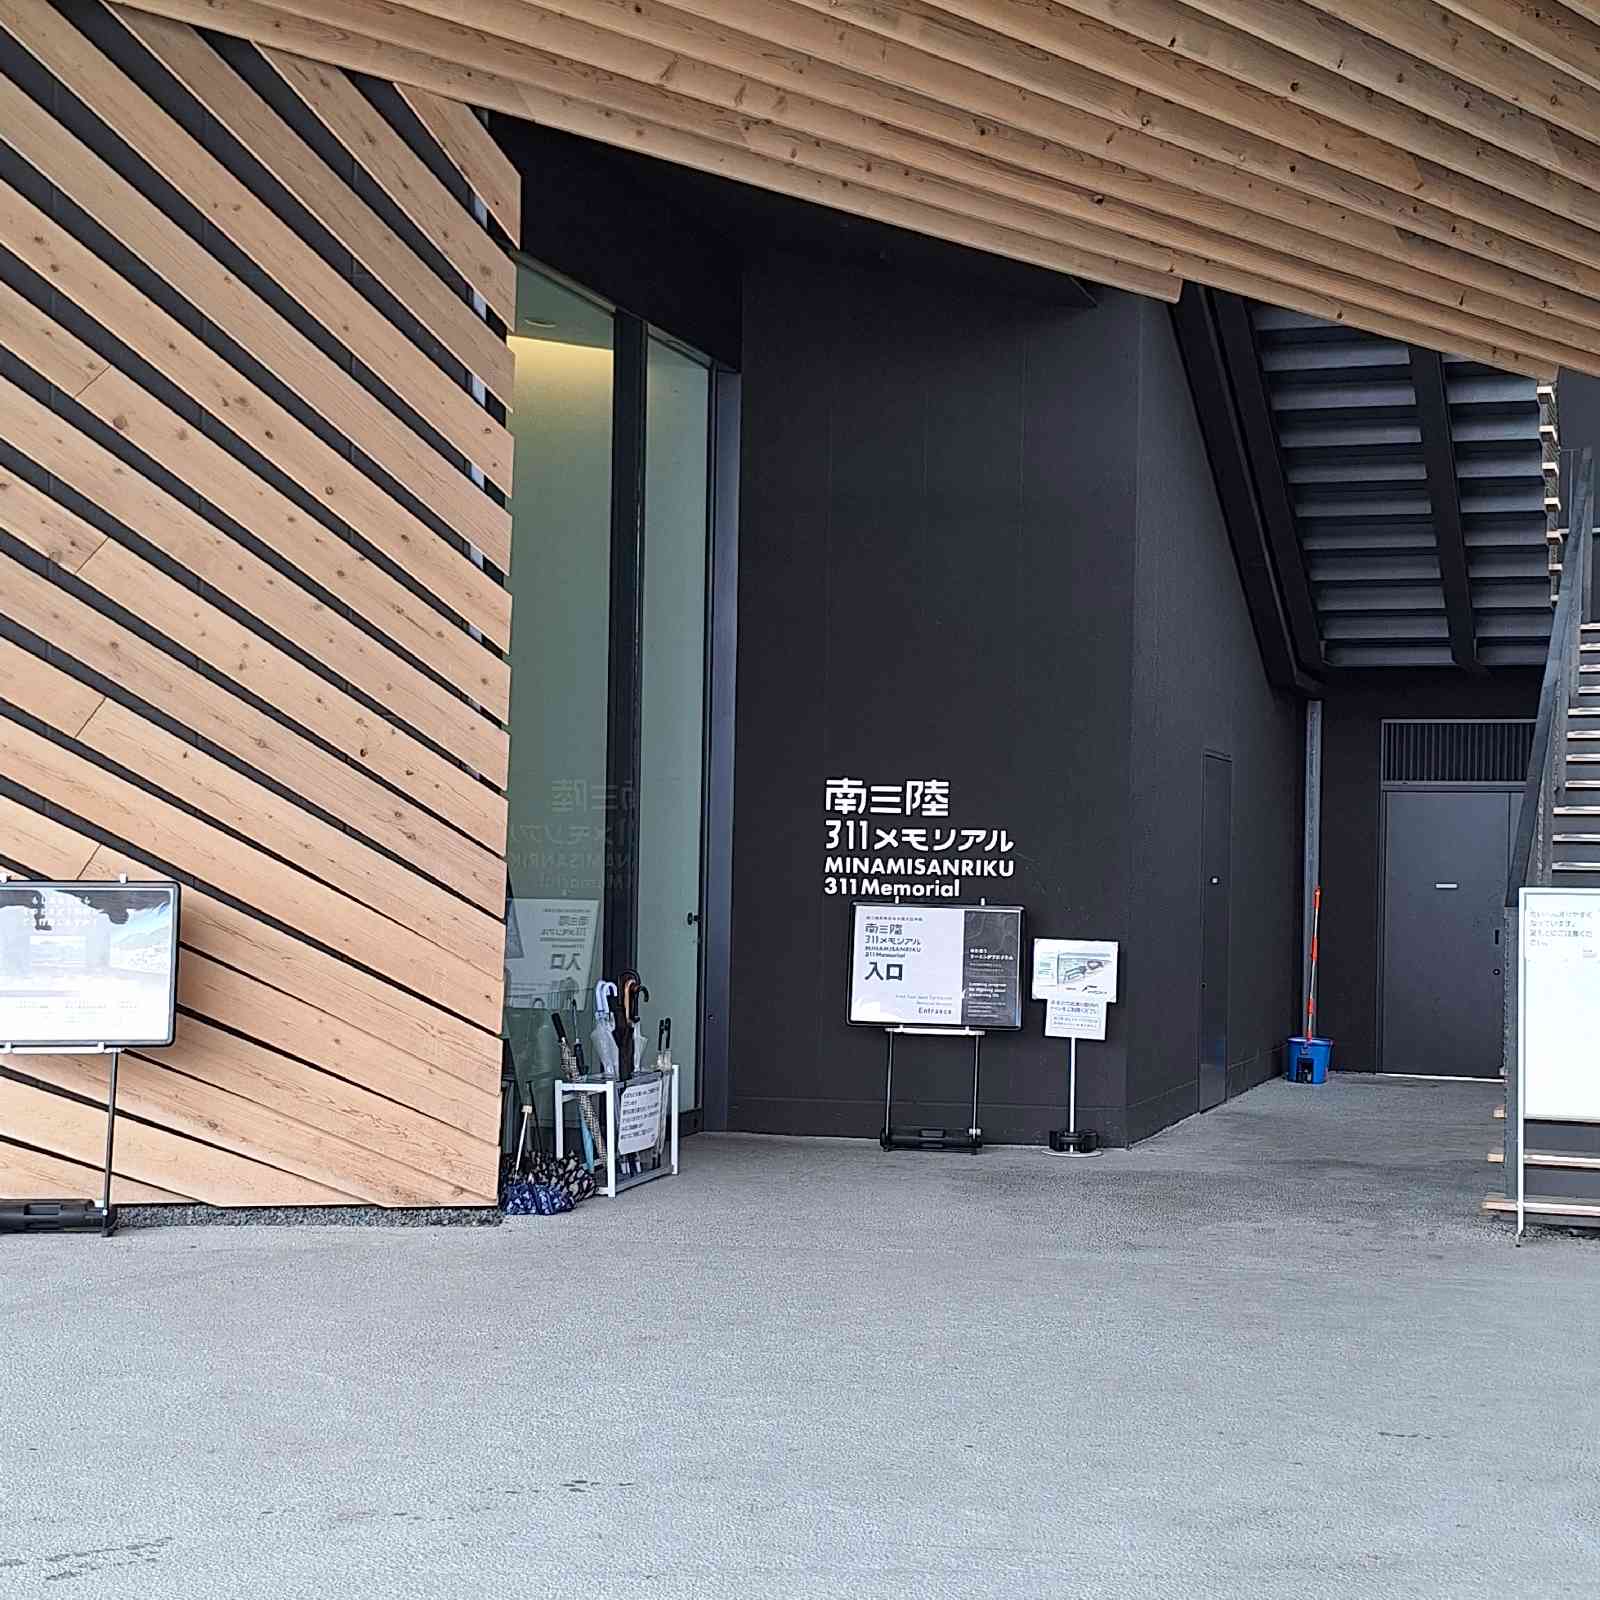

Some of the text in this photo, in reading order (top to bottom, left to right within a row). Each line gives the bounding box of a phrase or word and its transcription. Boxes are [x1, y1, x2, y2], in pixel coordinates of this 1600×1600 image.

[825, 778, 950, 816] 南三陸
[825, 820, 1014, 852] 311メモリアル
[824, 856, 1014, 877] MINAMISANRIKU
[865, 923, 903, 935] 南三陸
[864, 961, 903, 981] 入口
